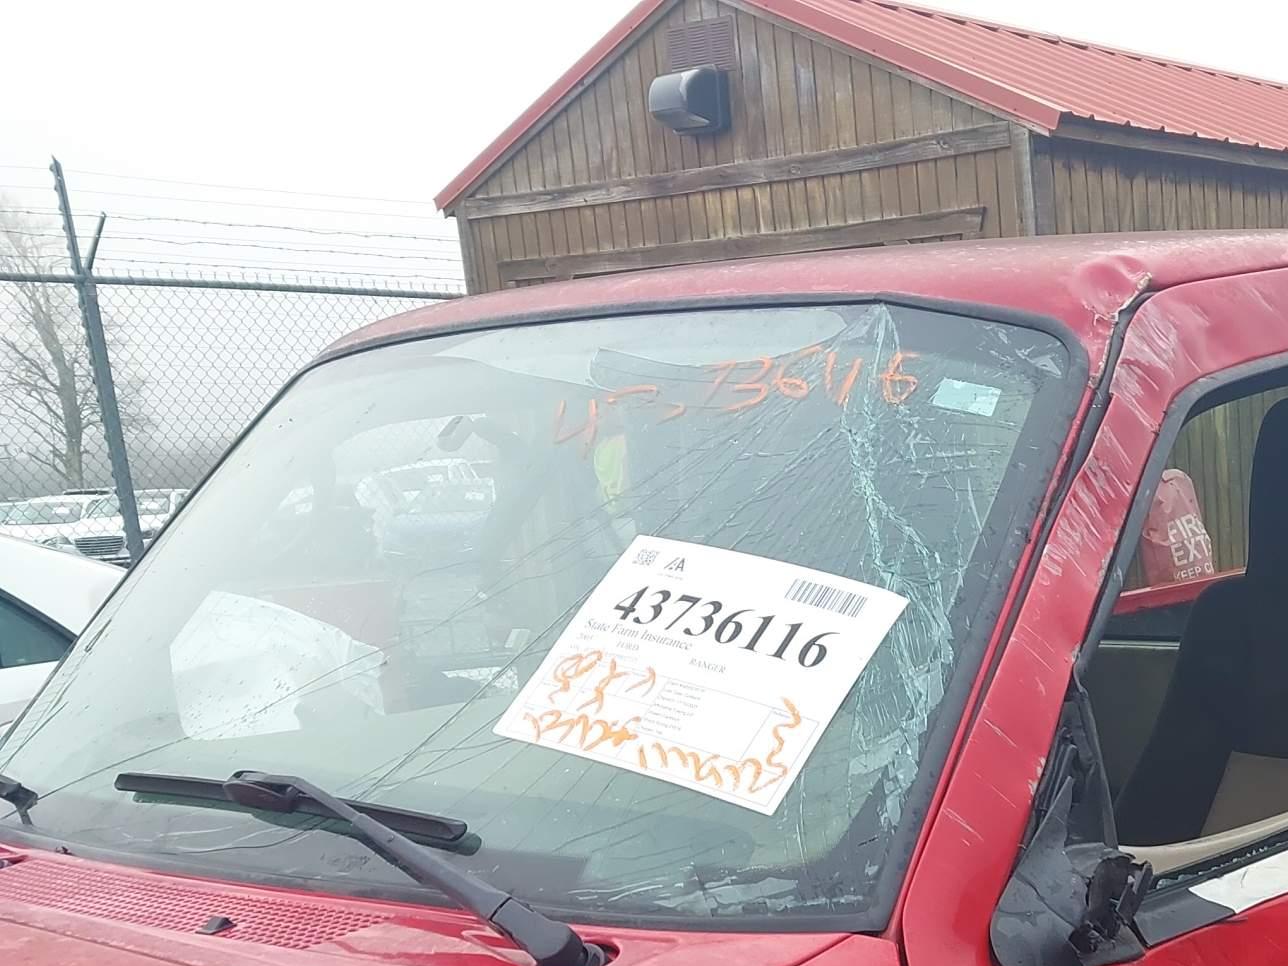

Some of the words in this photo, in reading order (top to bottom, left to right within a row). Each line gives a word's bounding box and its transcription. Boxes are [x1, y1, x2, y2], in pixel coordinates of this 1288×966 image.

[585, 618, 610, 632] State
[611, 623, 640, 638] Farm
[640, 629, 693, 651] Insurance
[613, 586, 840, 668] 43736116
[688, 657, 727, 674] RANGER
